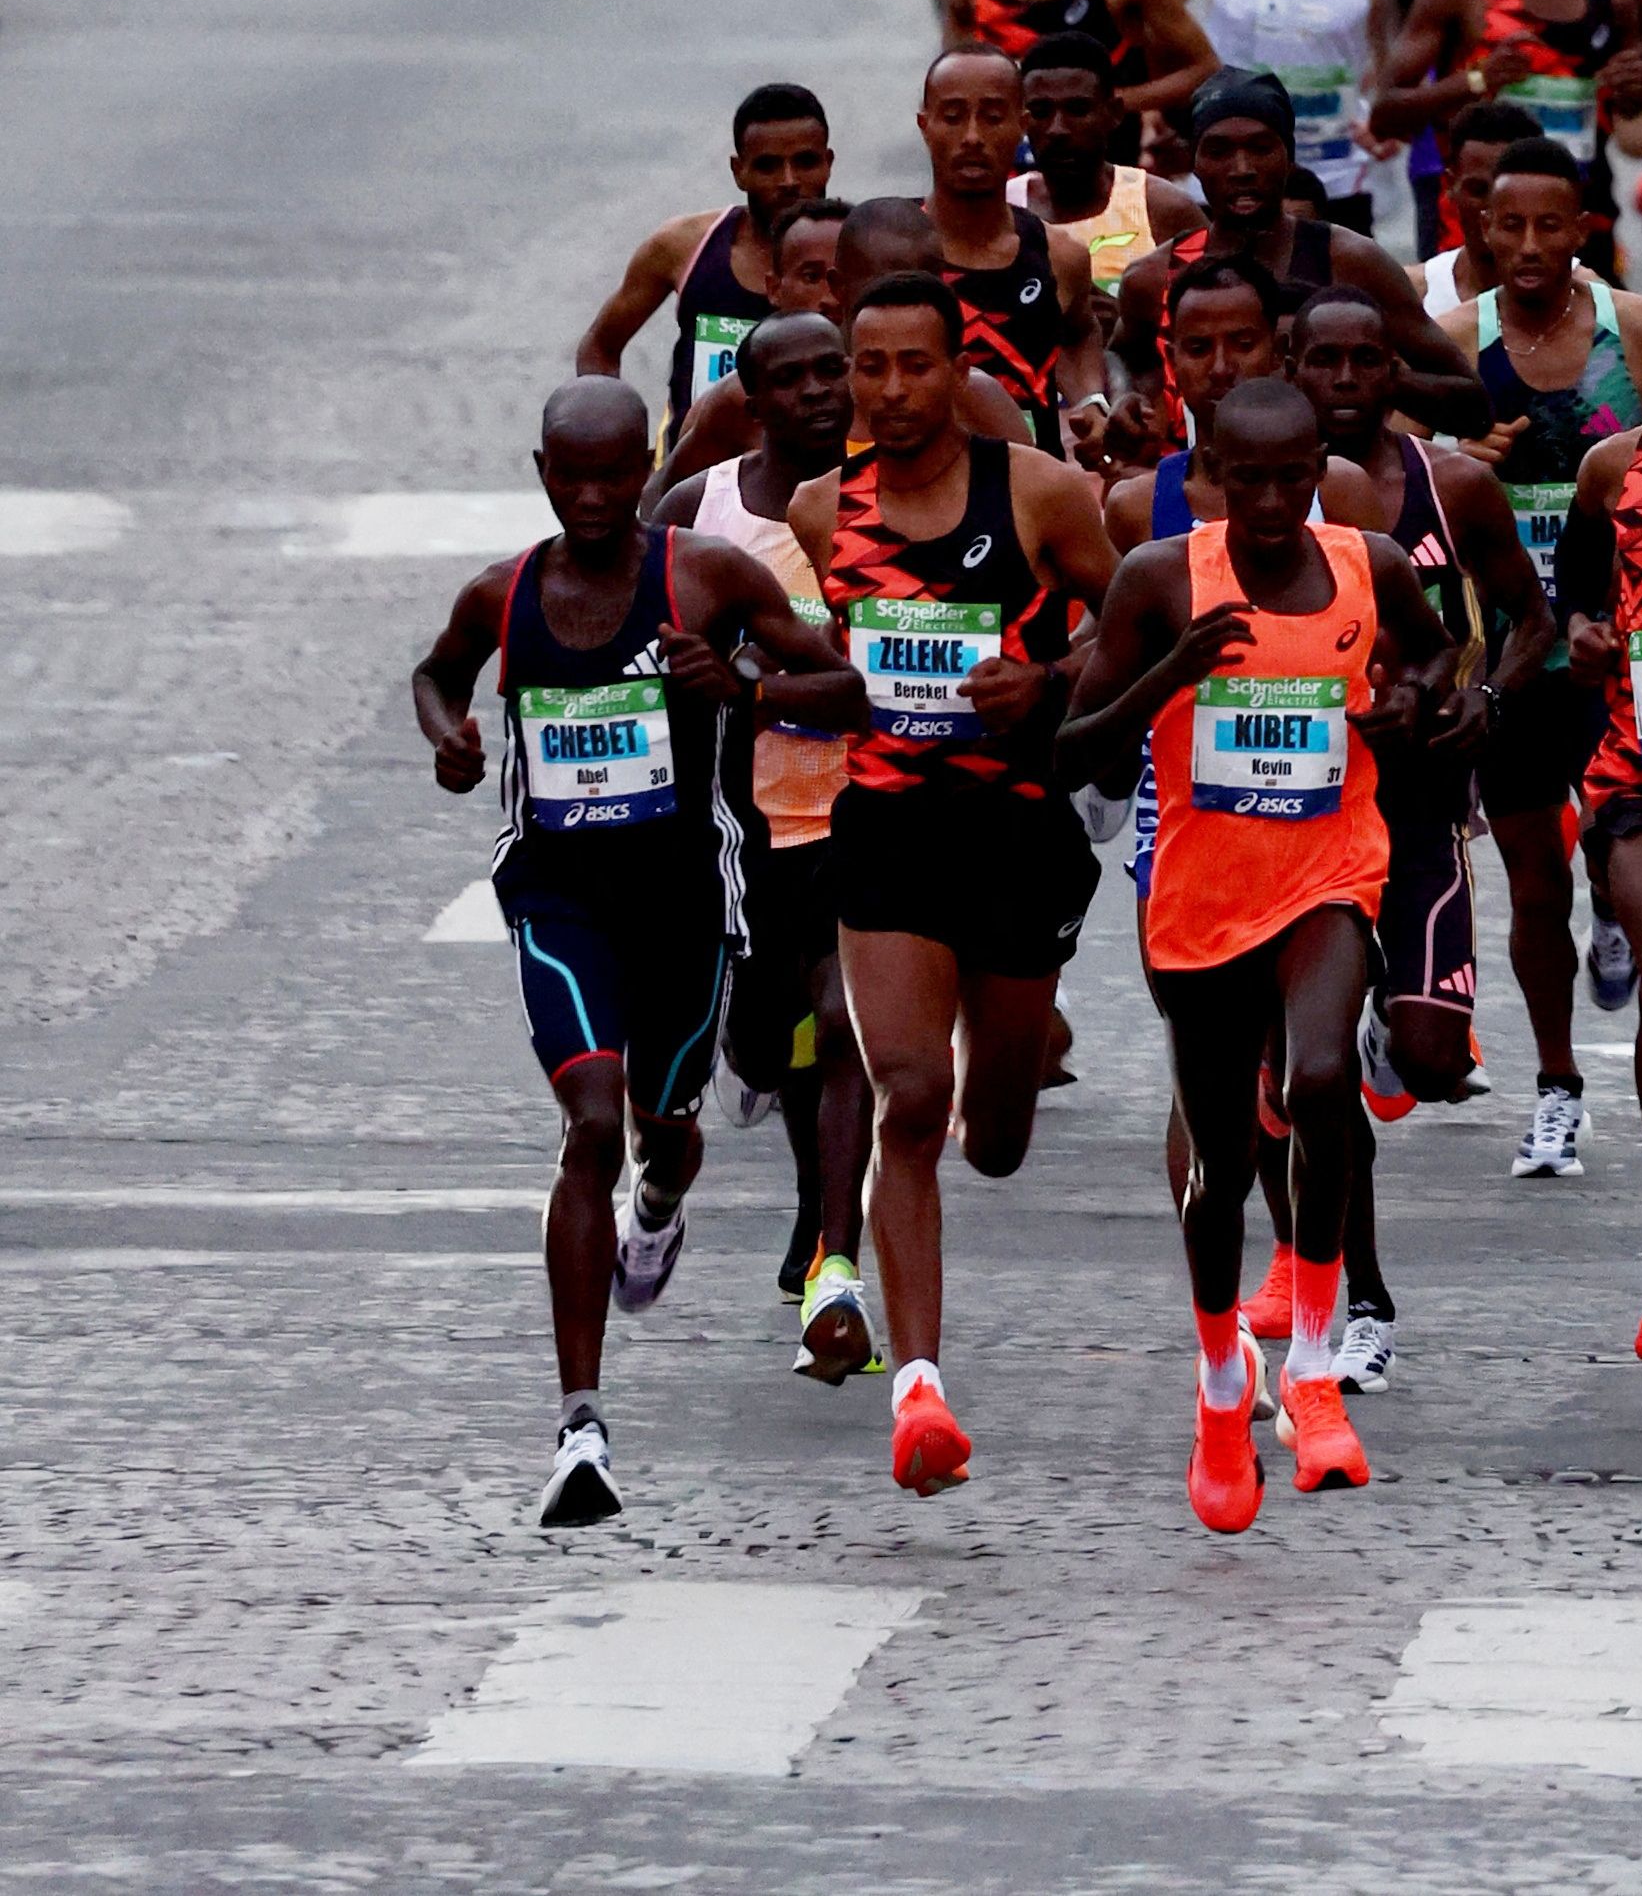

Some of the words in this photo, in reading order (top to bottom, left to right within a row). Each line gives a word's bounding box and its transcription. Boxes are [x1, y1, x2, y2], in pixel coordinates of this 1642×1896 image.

[876, 599, 968, 620] Schneider
[879, 636, 964, 674] ZELEKE
[894, 681, 949, 700] Bereket
[1226, 678, 1322, 695] Schneider
[909, 720, 953, 737] asics
[1234, 714, 1313, 749] KIBET
[543, 719, 638, 759] CHEBET
[577, 767, 608, 784] Abel
[650, 767, 668, 785] 30
[1252, 758, 1292, 776] Kevin
[1327, 767, 1341, 784] 31
[585, 803, 630, 822] asics
[1257, 797, 1304, 814] asics
